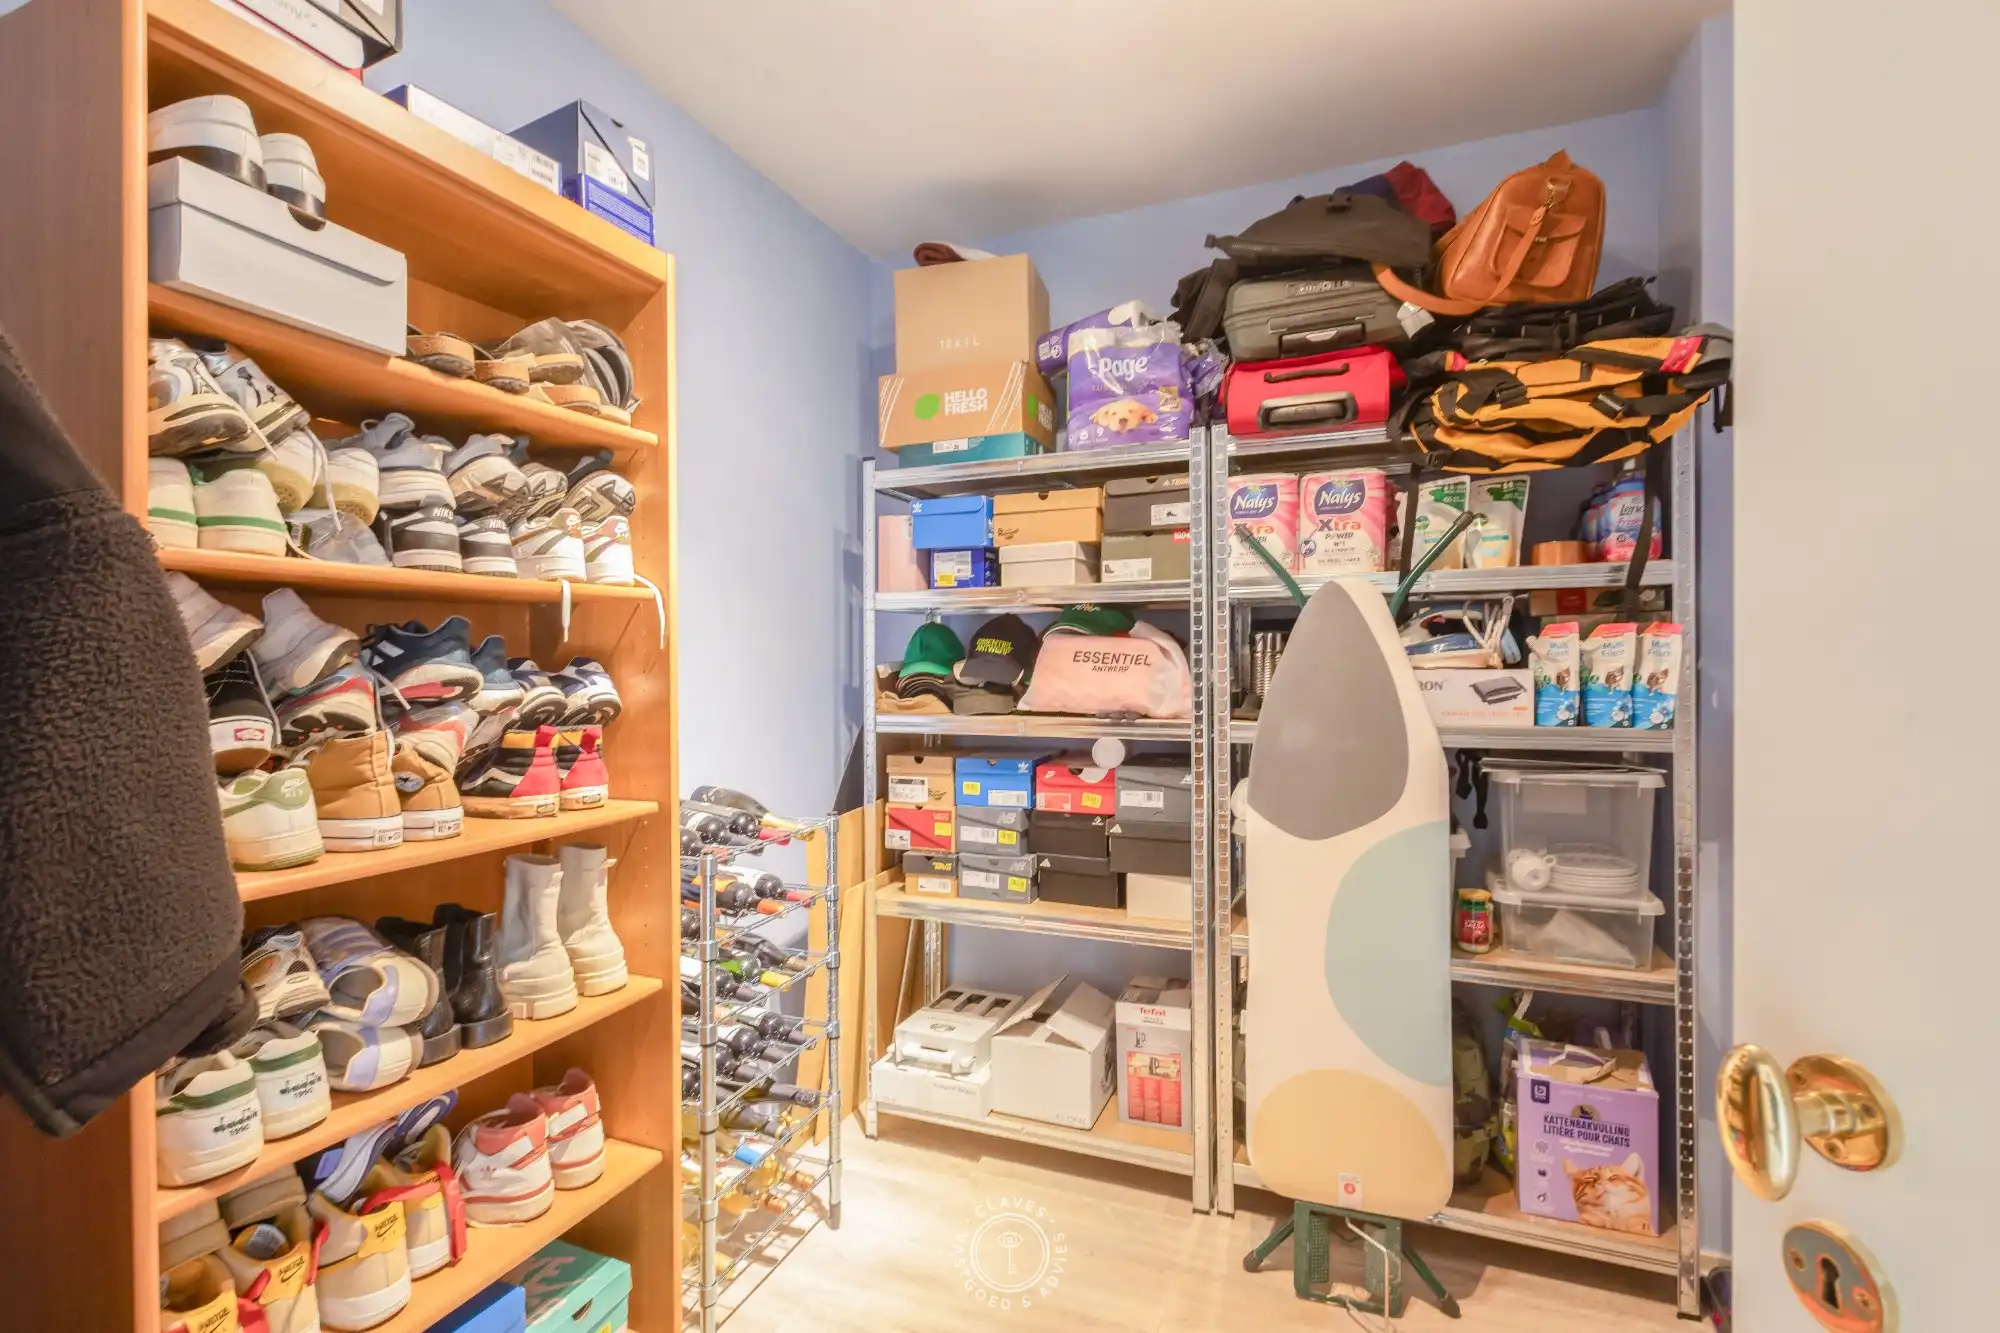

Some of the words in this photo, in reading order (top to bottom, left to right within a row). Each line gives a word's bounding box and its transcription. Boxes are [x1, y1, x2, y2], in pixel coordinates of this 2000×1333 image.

[1099, 356, 1148, 381] Page
[945, 388, 987, 402] HELLO
[945, 400, 988, 415] FRESH
[1234, 492, 1275, 513] Nalys
[1318, 488, 1362, 508] Nalys
[432, 507, 454, 520] NIKE
[489, 519, 507, 531] NIKE
[1318, 518, 1361, 531] Xtra
[977, 637, 1012, 649] ESSENTIEL
[1073, 651, 1151, 667] ESSENTIEL
[1092, 665, 1130, 673] ANTWERP
[1140, 1007, 1165, 1016] Tefal
[1543, 1113, 1630, 1137] KATTENBAKVULLING
[1577, 1130, 1600, 1142] POUR
[1602, 1134, 1630, 1148] CHATS
